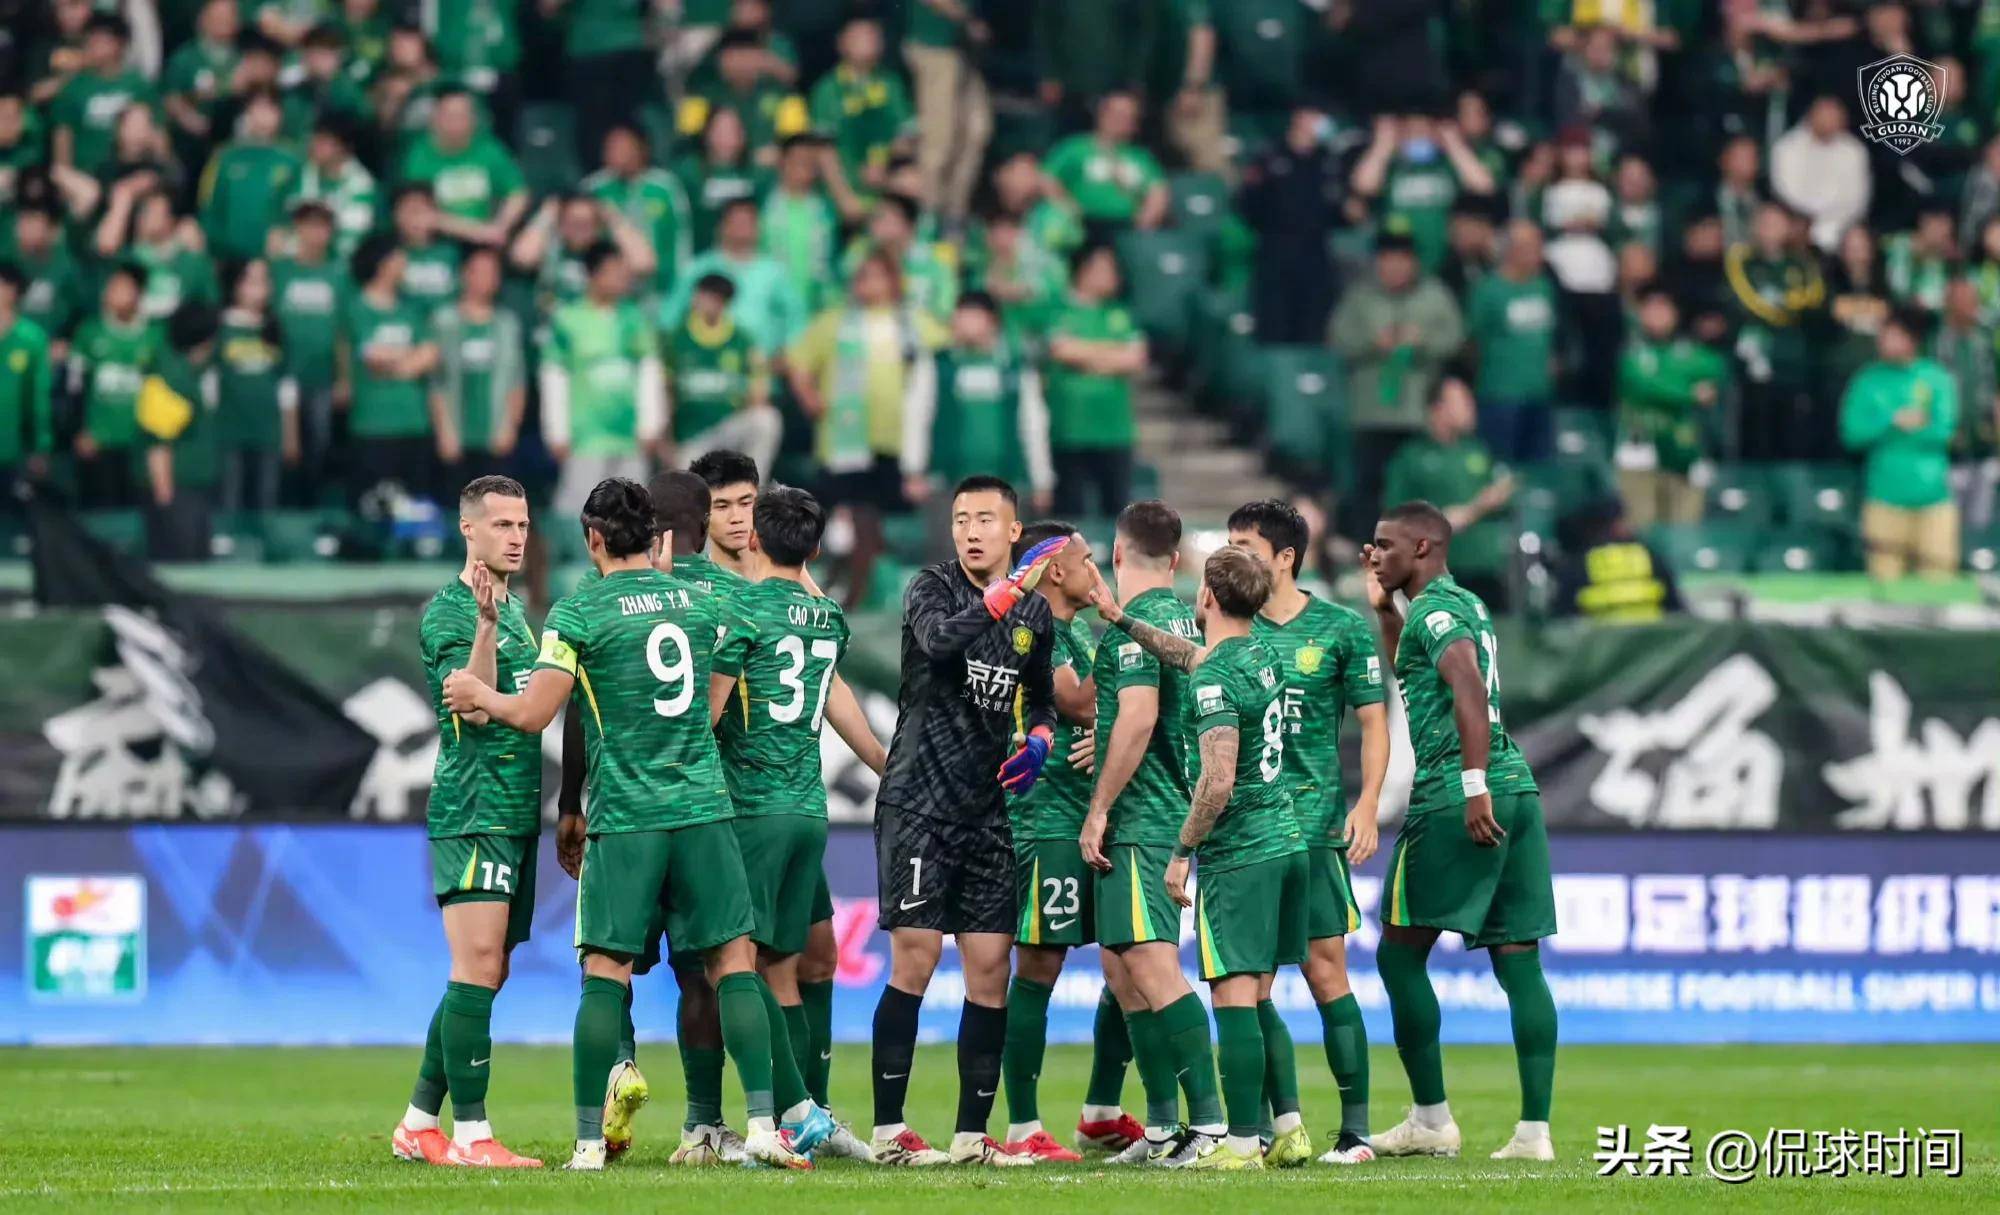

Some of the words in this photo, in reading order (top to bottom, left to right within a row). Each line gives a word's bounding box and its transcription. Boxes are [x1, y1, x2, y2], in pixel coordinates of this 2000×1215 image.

[617, 593, 663, 616] ZHANG
[666, 589, 694, 609] Y.N.
[788, 604, 807, 627] CAO
[812, 608, 831, 630] Y.J.
[646, 622, 695, 717] 9
[768, 635, 837, 732] 37
[964, 658, 1019, 698] 京东
[1259, 698, 1283, 783] 8
[481, 861, 512, 893] 15
[910, 857, 922, 896] 1
[1042, 877, 1080, 915] 23
